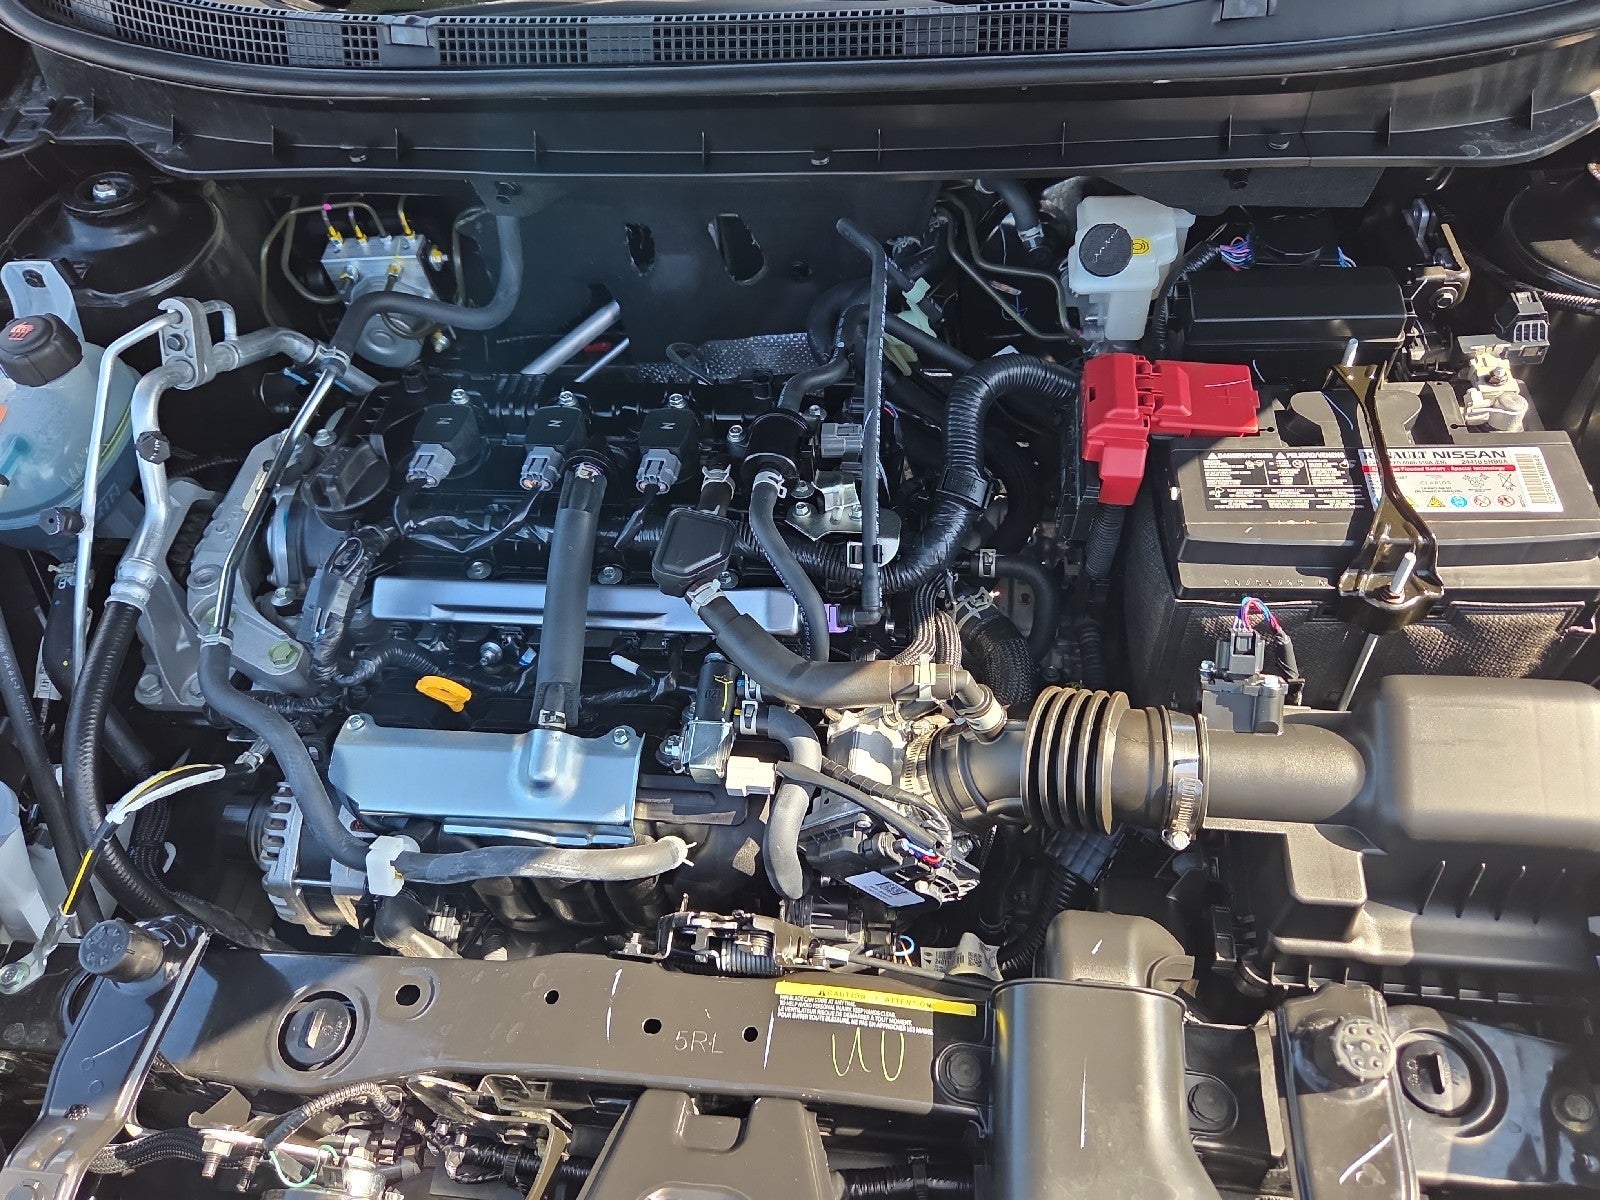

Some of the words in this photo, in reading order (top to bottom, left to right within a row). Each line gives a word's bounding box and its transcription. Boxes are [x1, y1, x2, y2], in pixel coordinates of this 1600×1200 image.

[1363, 451, 1427, 459] RAULT
[1432, 451, 1506, 459] NISSAN
[826, 990, 866, 1000] CAUTION
[884, 997, 932, 1007] ATTENTION
[813, 1003, 835, 1011] PERSONAL
